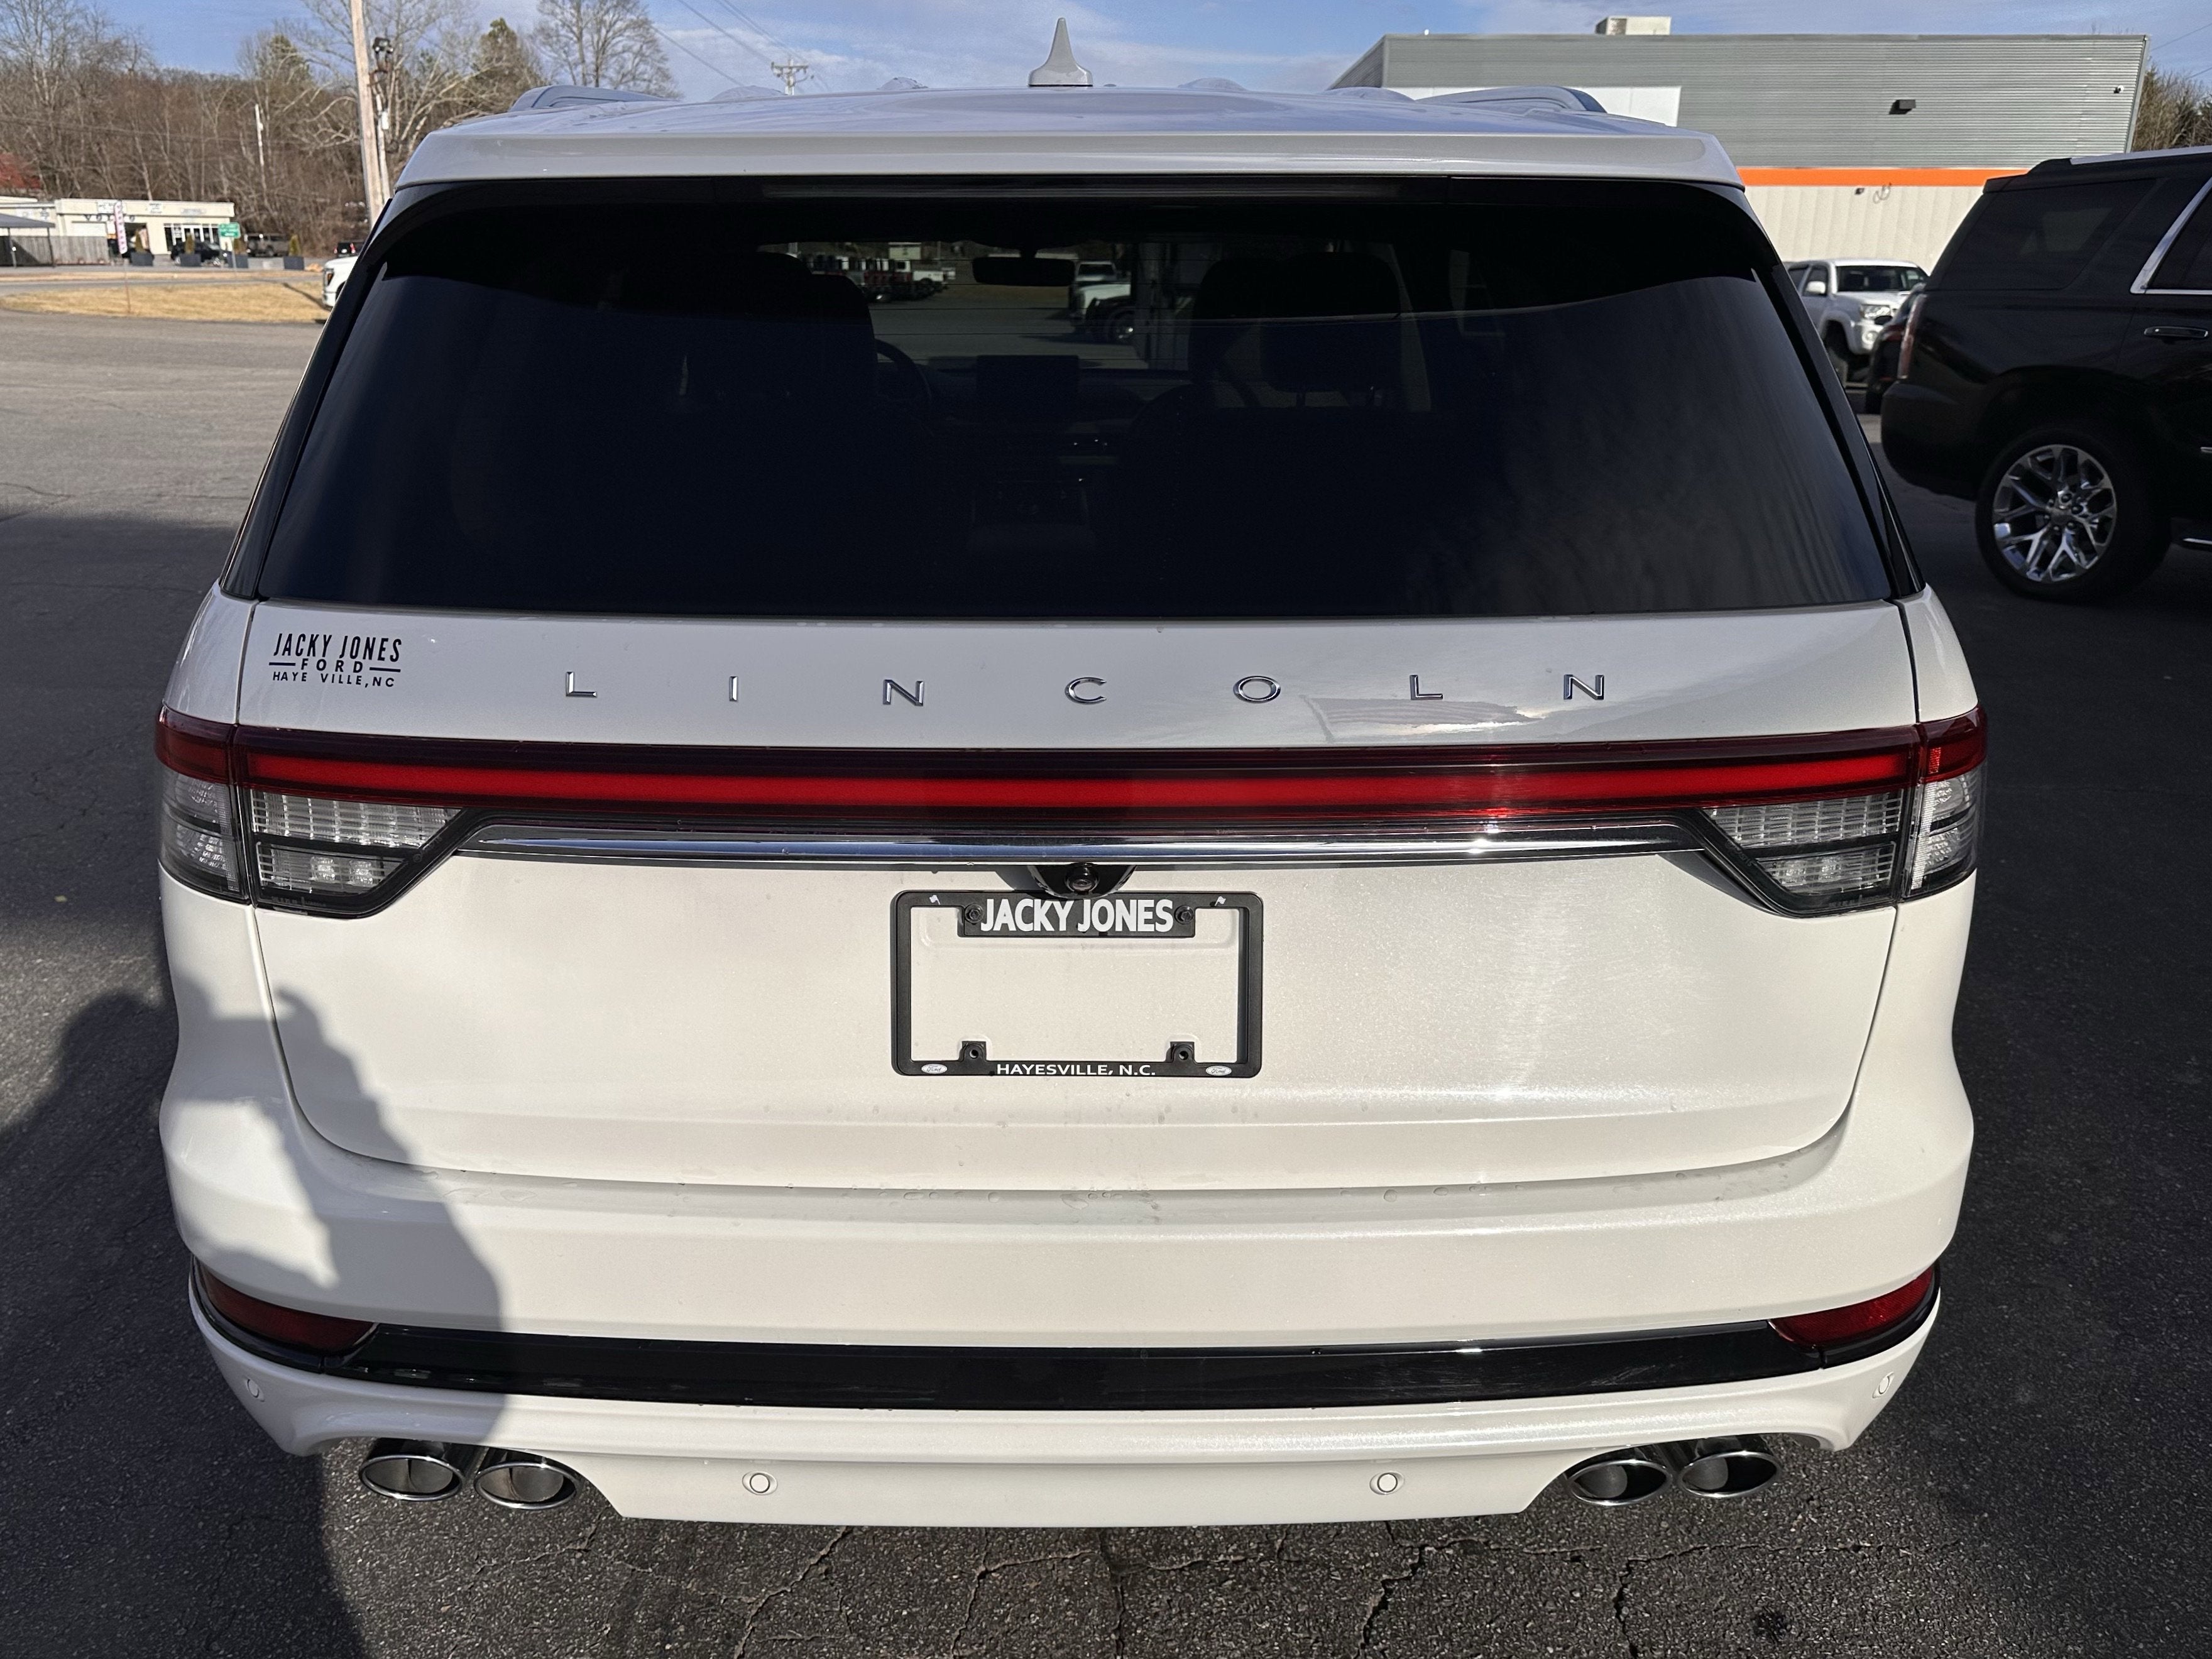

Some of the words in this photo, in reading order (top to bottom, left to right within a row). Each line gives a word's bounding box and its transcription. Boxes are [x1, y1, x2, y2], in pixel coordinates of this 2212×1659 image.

[273, 633, 332, 657] JACKY
[339, 635, 402, 662] JONES
[301, 658, 363, 673] FORD
[566, 671, 1604, 706] LINCOLN
[980, 899, 1074, 932] JACKY
[1077, 899, 1174, 933] JONES
[997, 1064, 1113, 1075] HAYESVILLE,
[1119, 1065, 1156, 1076] N.C.
